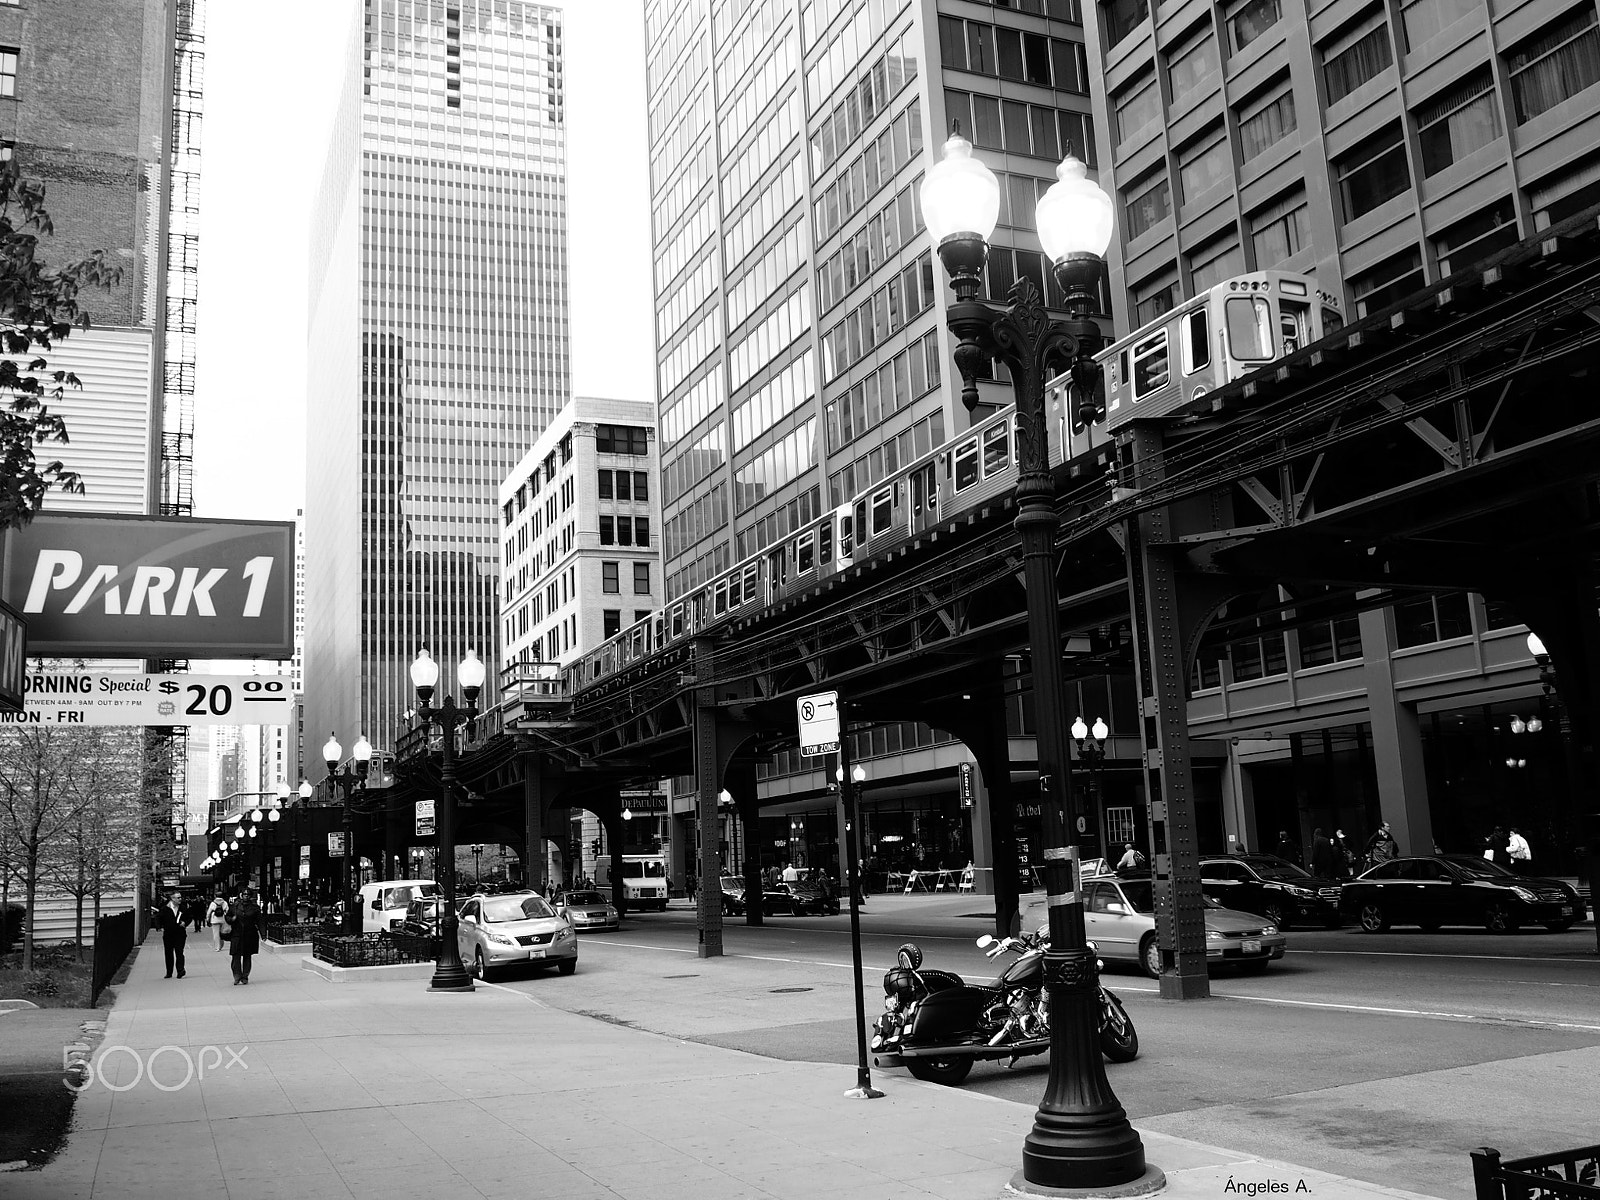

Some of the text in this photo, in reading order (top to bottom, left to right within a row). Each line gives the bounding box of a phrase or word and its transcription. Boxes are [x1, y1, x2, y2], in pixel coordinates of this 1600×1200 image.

[23, 549, 275, 618] PARK 1
[24, 675, 152, 695] ORNING Special
[185, 684, 232, 716] 20
[243, 681, 283, 693] 00
[1, 711, 41, 723] MON
[57, 711, 84, 723] FRI
[805, 742, 836, 754] TOW ZONE
